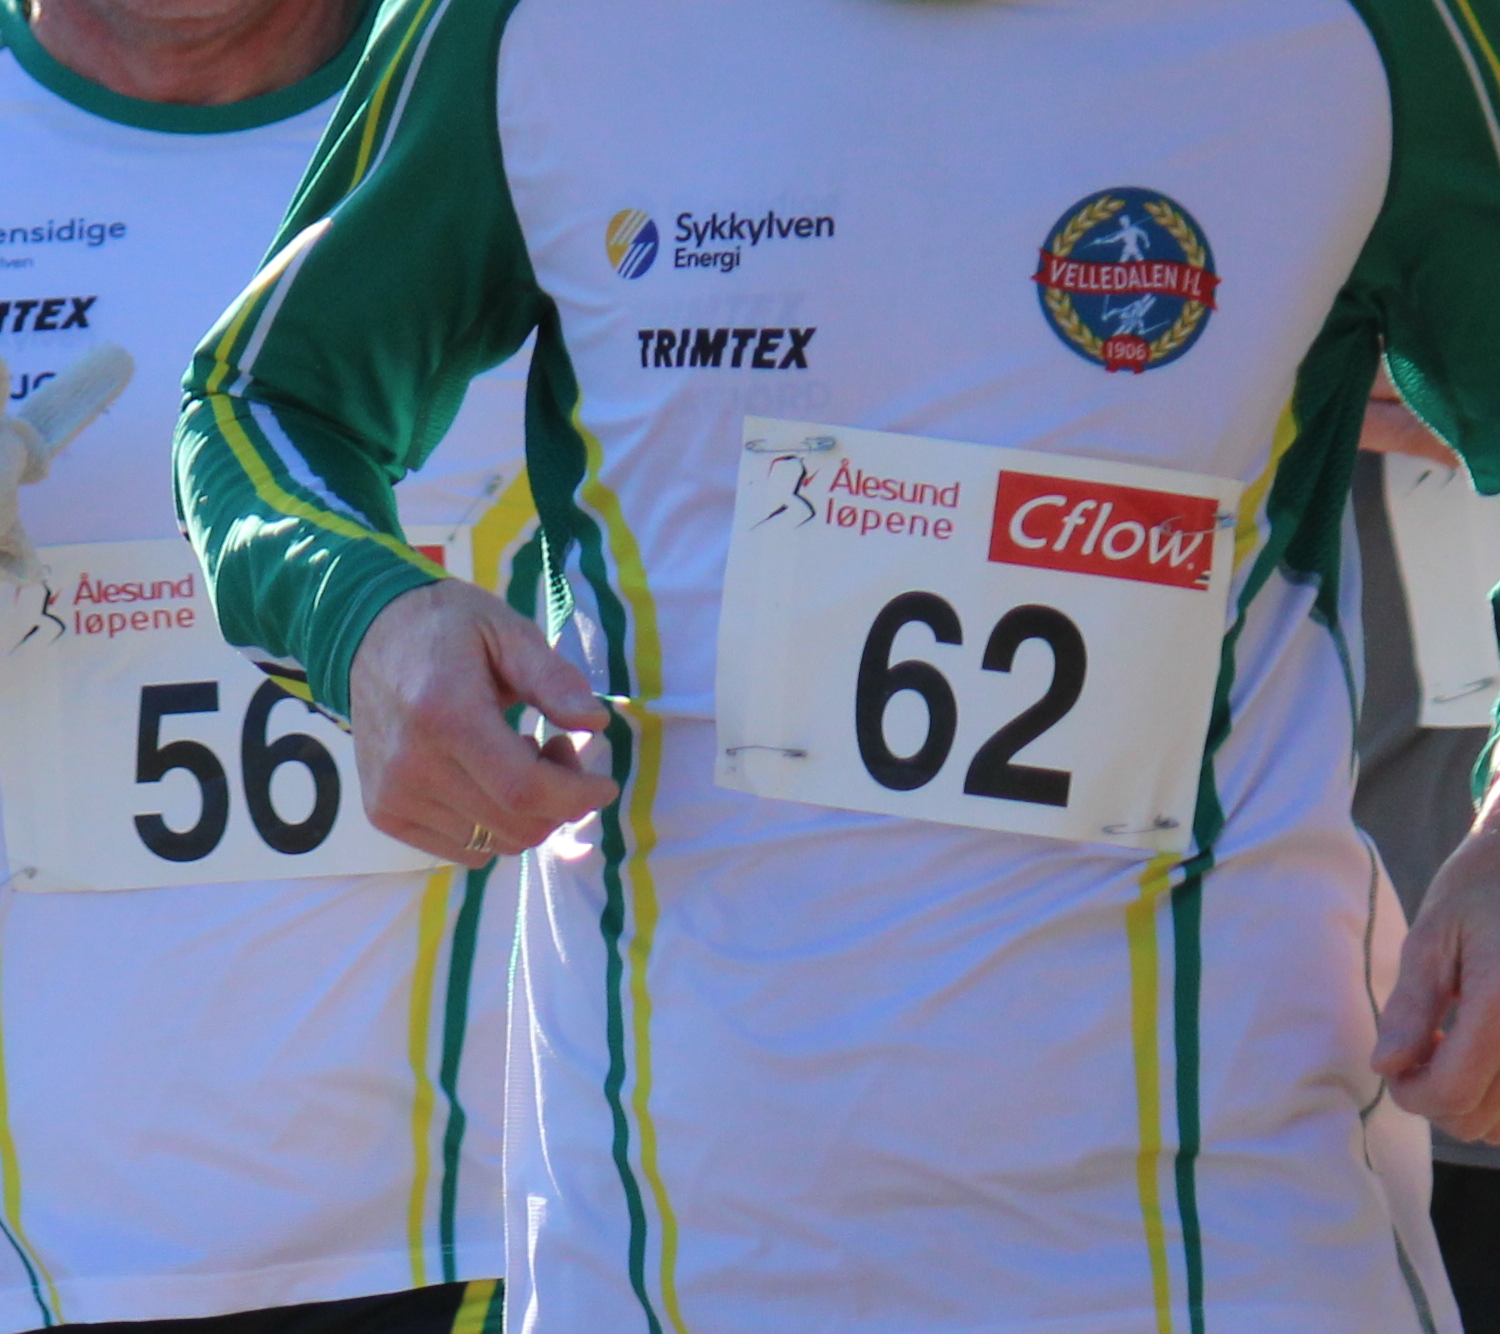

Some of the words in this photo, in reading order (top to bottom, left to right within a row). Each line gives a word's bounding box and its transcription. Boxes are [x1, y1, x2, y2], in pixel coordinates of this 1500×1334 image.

[675, 210, 836, 247] Sykkylven
[674, 246, 742, 273] Energi
[1050, 259, 1179, 290] VELLEDALEN
[638, 327, 818, 370] TRIMTEX
[1106, 342, 1147, 360] 1906
[829, 459, 960, 509] Ålesund
[825, 499, 954, 541] løpene
[73, 572, 195, 606] Ålesund
[74, 605, 196, 638] løpene
[855, 590, 1088, 808] 62
[133, 676, 342, 863] 56
